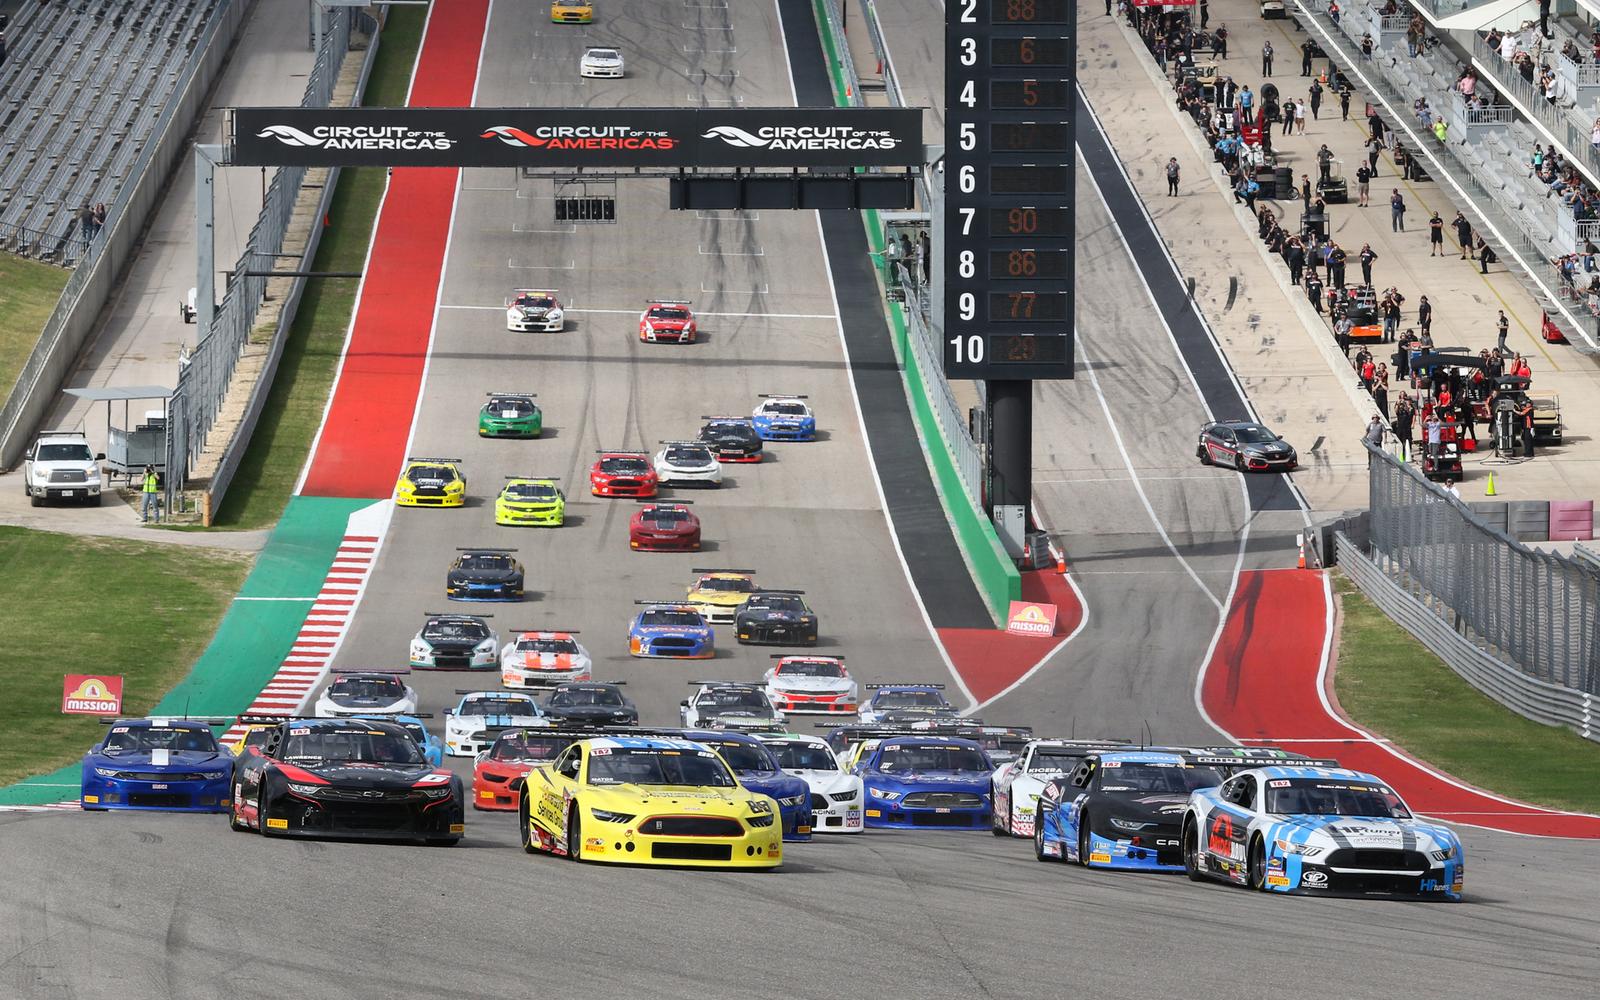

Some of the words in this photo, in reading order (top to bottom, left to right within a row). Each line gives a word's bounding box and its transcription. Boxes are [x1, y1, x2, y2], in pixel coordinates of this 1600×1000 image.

[960, 0, 977, 23] 2
[960, 37, 977, 66] 3
[1020, 39, 1033, 64] 6
[959, 80, 977, 108] 4
[1023, 81, 1039, 106] 5
[313, 126, 408, 138] CIRCUIT
[322, 138, 452, 150] AMERICAS
[535, 126, 631, 138] CIRCUIT
[545, 138, 674, 150] AMERICAS
[758, 126, 853, 138] CIRCUIT
[768, 138, 897, 150] AMERICAS
[959, 122, 976, 151] 5
[959, 165, 976, 193] 6
[959, 208, 976, 235] 7
[1008, 208, 1037, 233] 90
[959, 250, 976, 278] 8
[1008, 250, 1037, 276] 86
[959, 293, 976, 321] 9
[1009, 293, 1036, 318] 77
[950, 335, 984, 363] 10
[639, 643, 650, 654] 14
[1271, 780, 1290, 788] TA2
